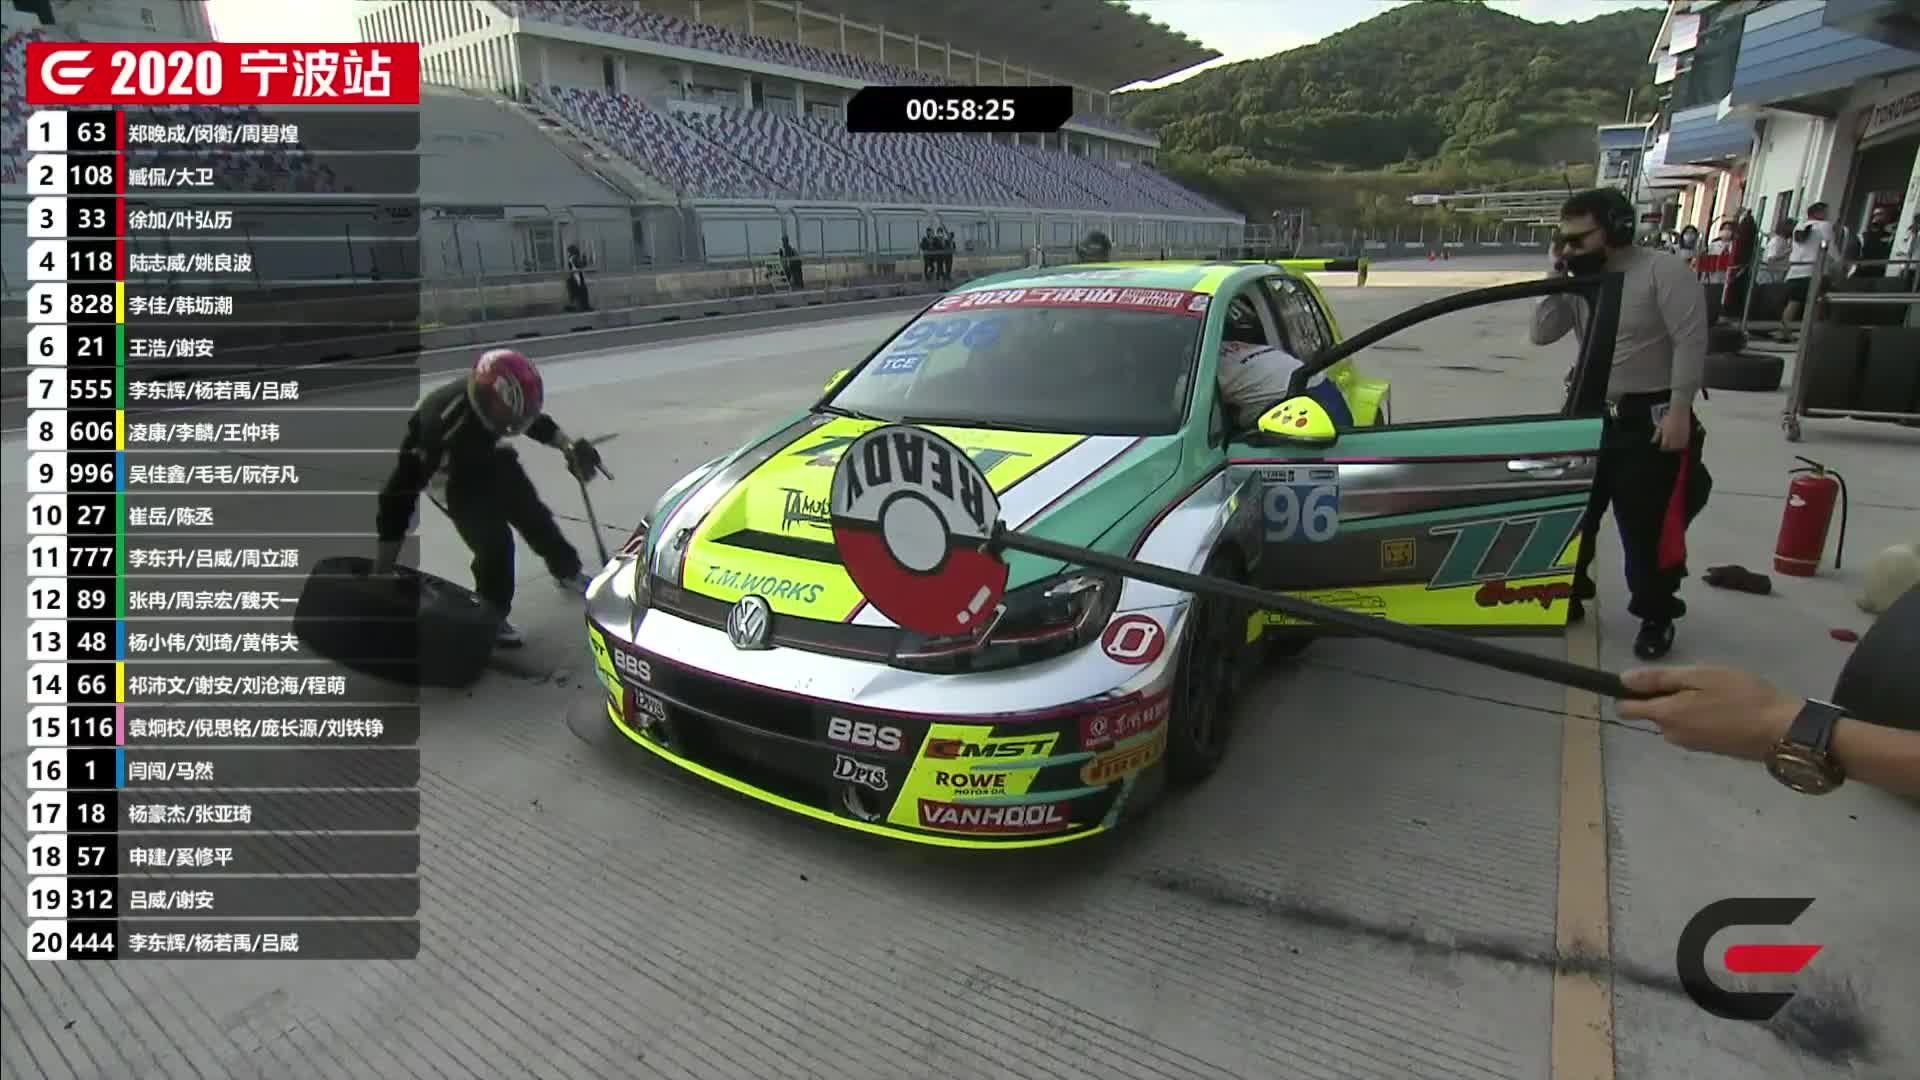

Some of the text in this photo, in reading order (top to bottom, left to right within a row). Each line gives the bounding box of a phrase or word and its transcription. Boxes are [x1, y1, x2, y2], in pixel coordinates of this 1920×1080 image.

[882, 357, 918, 370] TCE
[845, 432, 990, 532] READY
[613, 648, 652, 681] BBS
[828, 717, 902, 751] BBS
[935, 771, 1006, 788] ROWE
[954, 788, 988, 796] MOTOR
[922, 803, 1064, 826] VANHOOL
